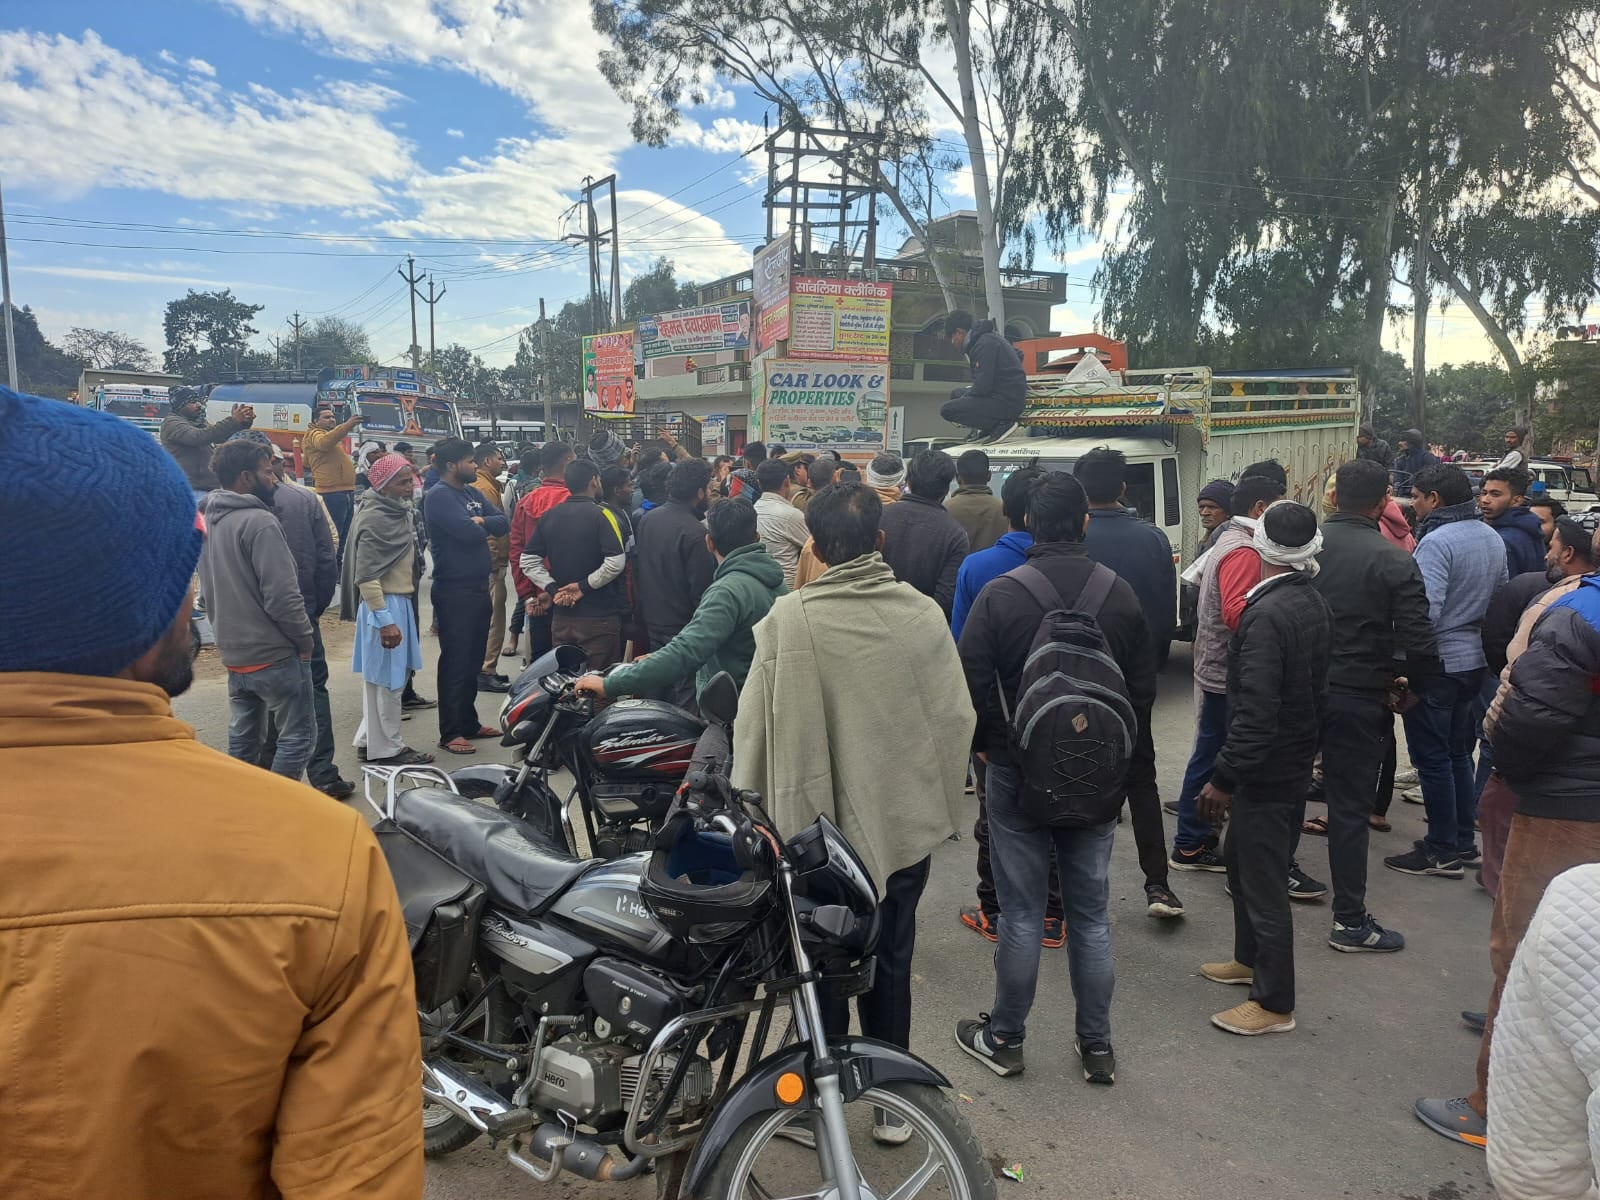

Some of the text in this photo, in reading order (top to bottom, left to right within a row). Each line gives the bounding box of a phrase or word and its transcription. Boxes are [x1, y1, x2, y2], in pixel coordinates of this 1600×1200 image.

[769, 373, 885, 389] CAR LOOK &
[768, 390, 856, 406] PROPERTIES
[544, 1072, 565, 1088] Hero
